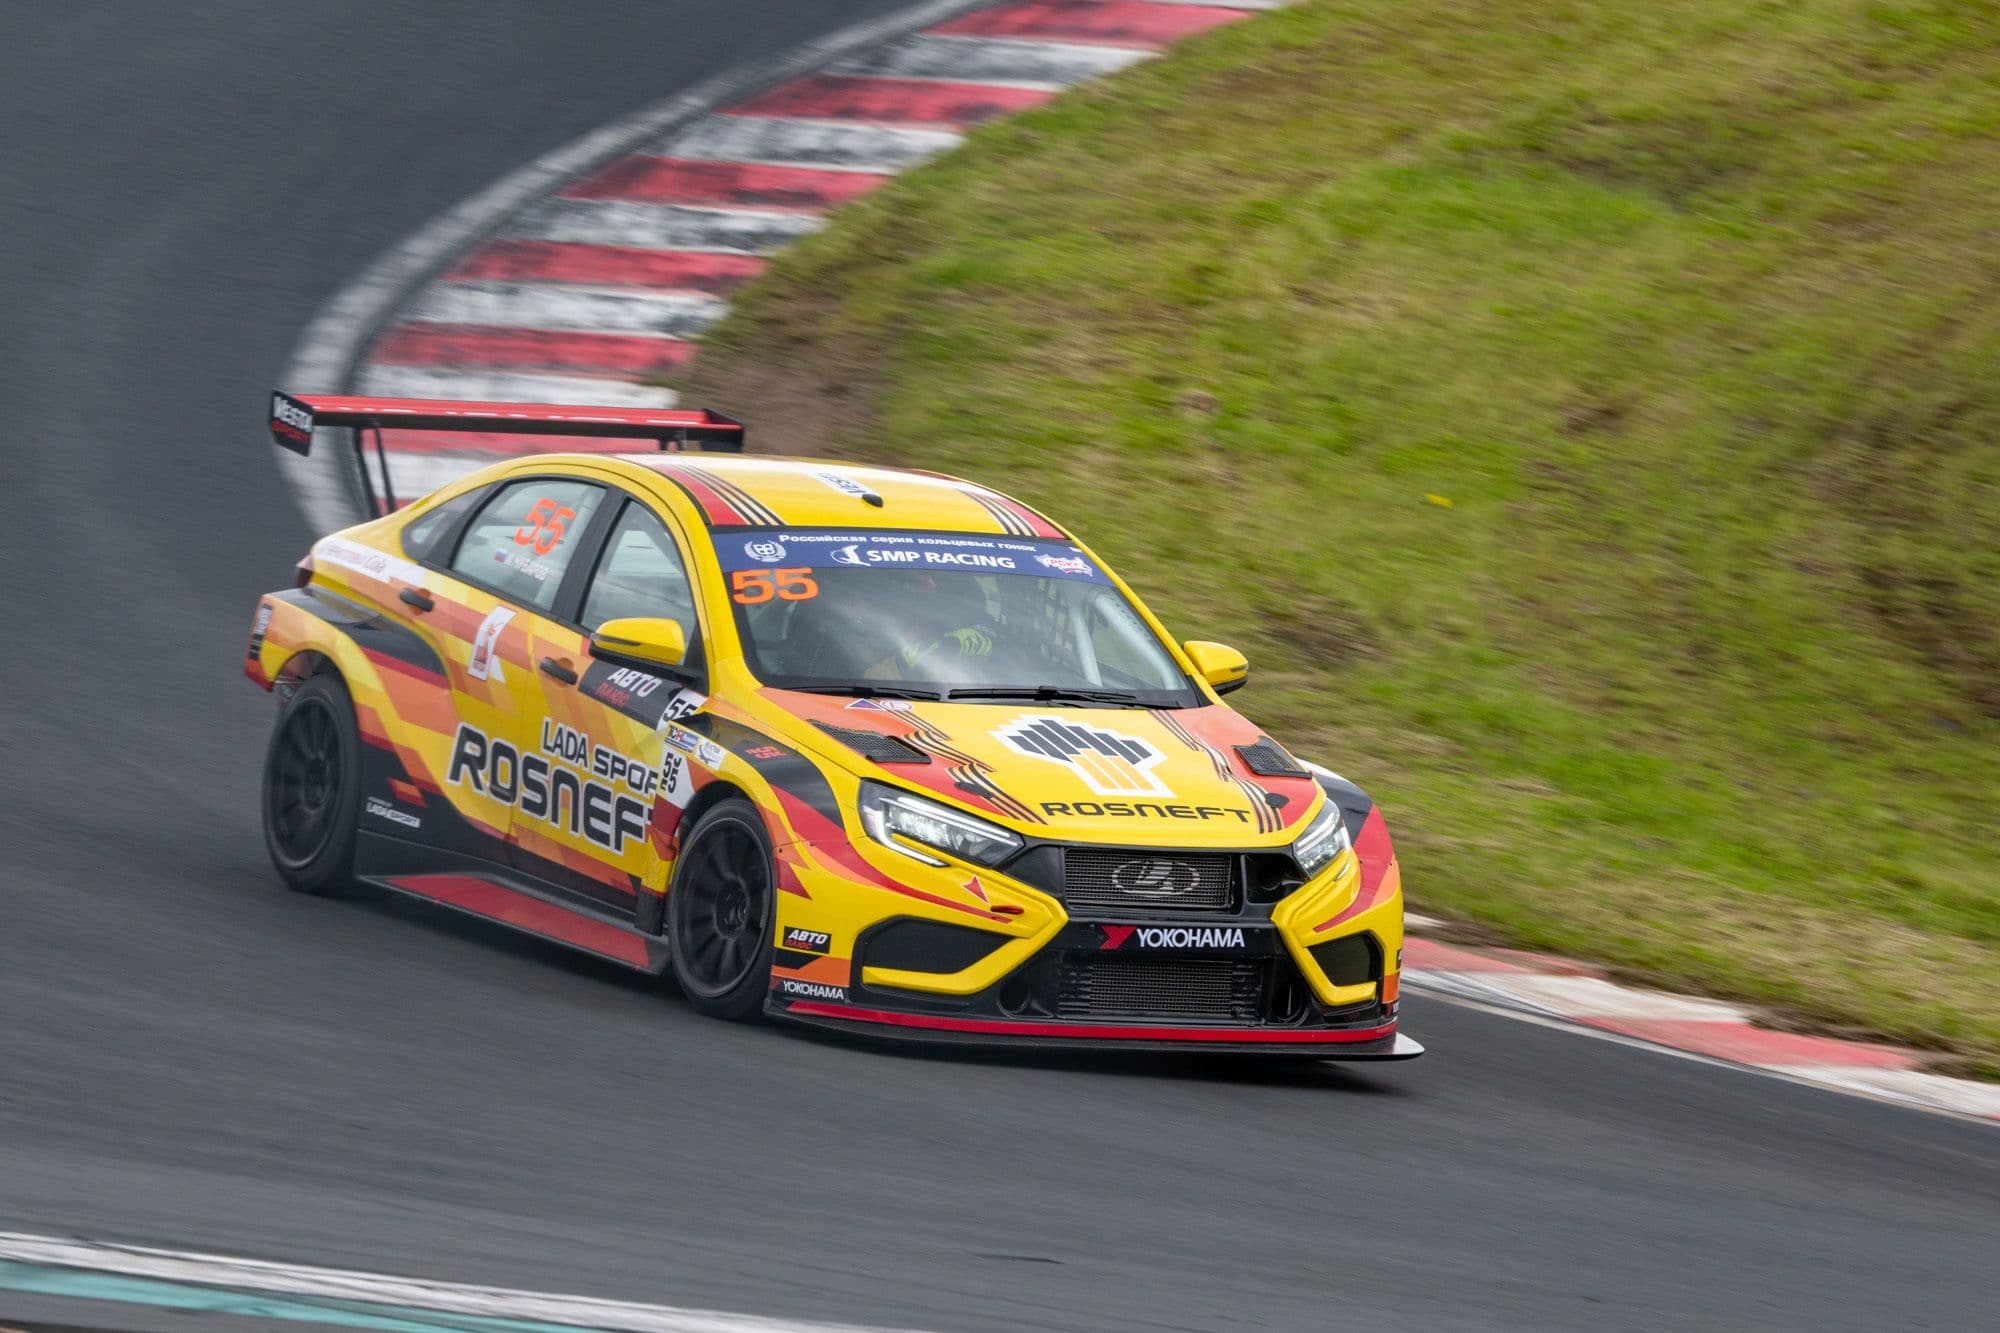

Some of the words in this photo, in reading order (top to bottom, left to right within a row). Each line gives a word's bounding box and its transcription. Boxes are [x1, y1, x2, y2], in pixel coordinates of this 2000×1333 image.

[513, 496, 577, 556] 55
[778, 534, 867, 543] Российская
[871, 536, 914, 544] серия
[918, 538, 996, 549] кольцевых
[998, 542, 1037, 552] гонок
[866, 550, 920, 563] SMP
[925, 551, 1016, 569] RACING
[732, 567, 819, 605] 55
[607, 667, 662, 698] АВТО
[541, 716, 590, 769] LADA
[447, 722, 656, 856] ROSNEF
[1040, 802, 1250, 823] ROSNEFT
[788, 929, 828, 945] АВТО
[1136, 928, 1245, 948] YOKOHAMA
[783, 980, 844, 1000] YOKOHAMA
